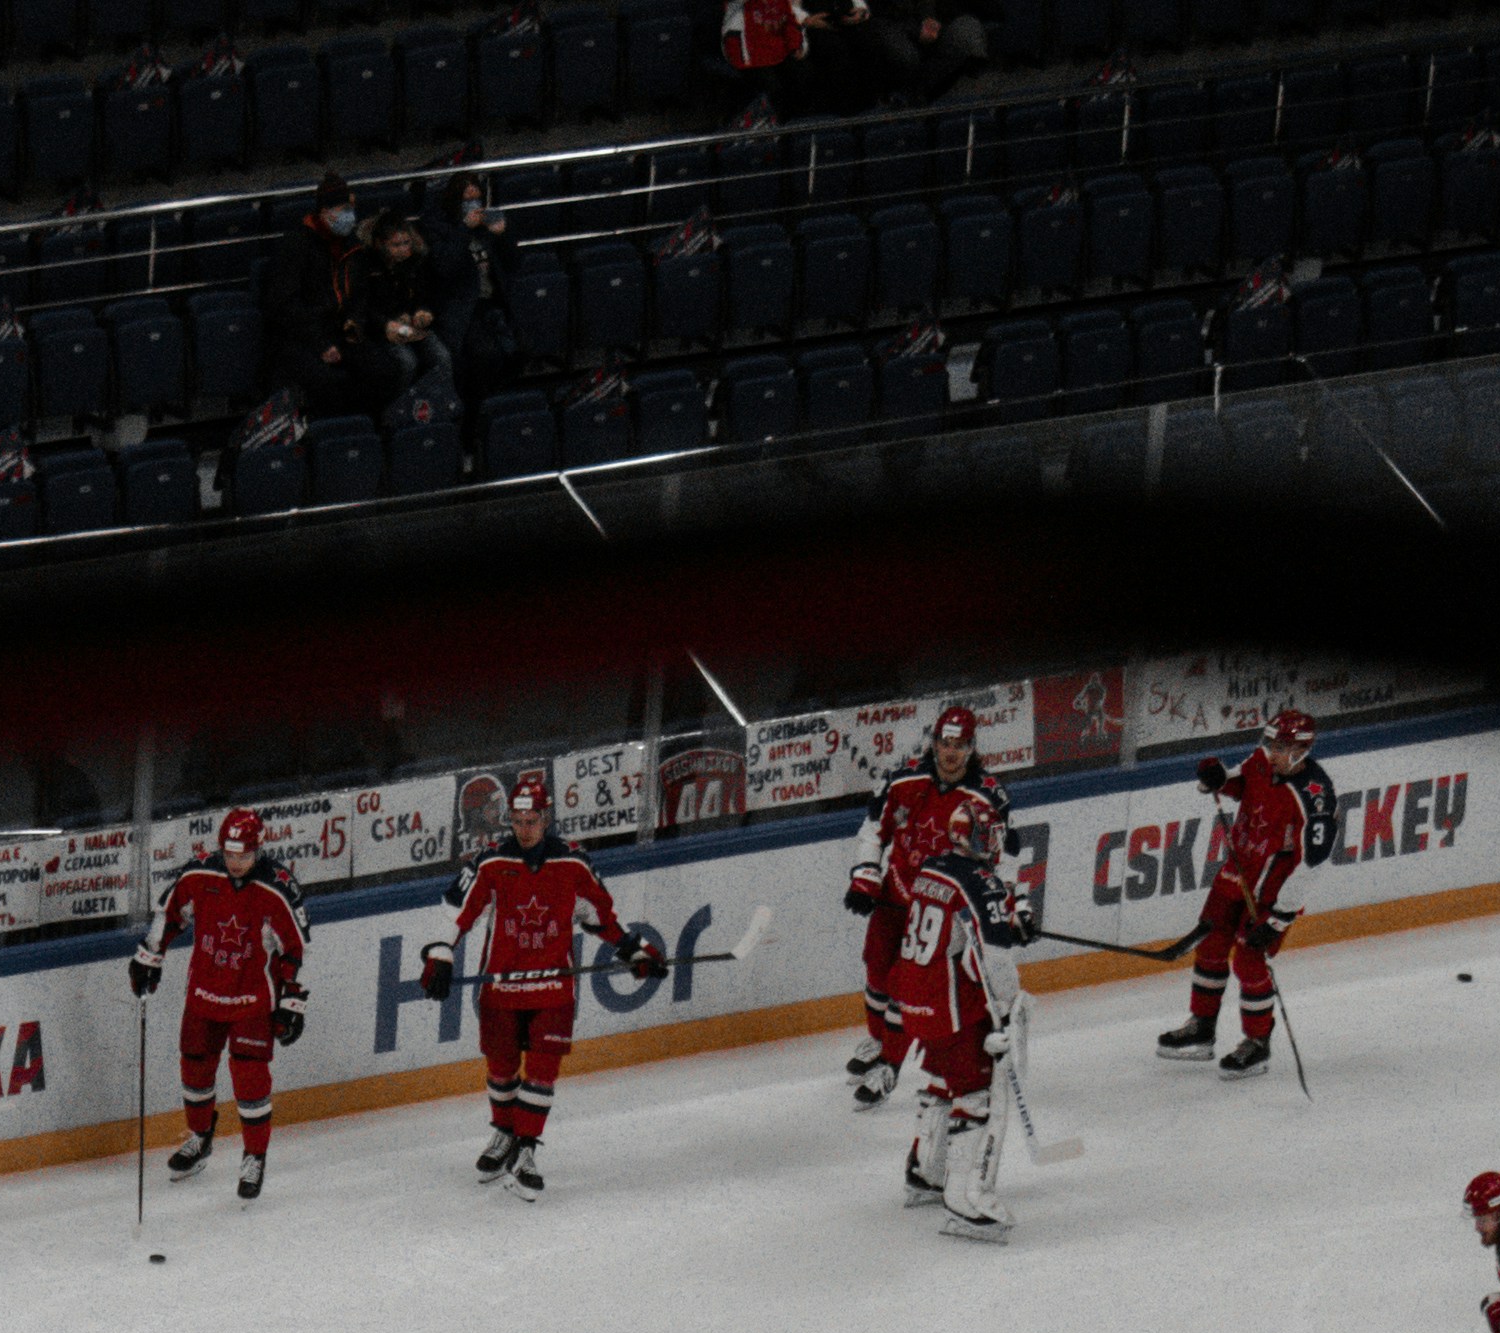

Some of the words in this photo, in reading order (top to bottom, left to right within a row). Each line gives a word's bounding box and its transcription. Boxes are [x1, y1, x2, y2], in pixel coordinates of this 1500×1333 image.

[873, 731, 894, 756] 98
[576, 752, 624, 779] BEST
[565, 784, 579, 808] 6
[595, 780, 613, 806] &
[621, 773, 643, 797] 37
[189, 818, 214, 836] МЫ
[556, 807, 636, 835] DEFENSEME
[1311, 822, 1326, 846] 3
[320, 816, 347, 860] 15
[410, 827, 446, 862] GO!
[72, 896, 116, 915] ЦВЕТА
[901, 899, 946, 968] 39
[374, 904, 713, 1055] Her
